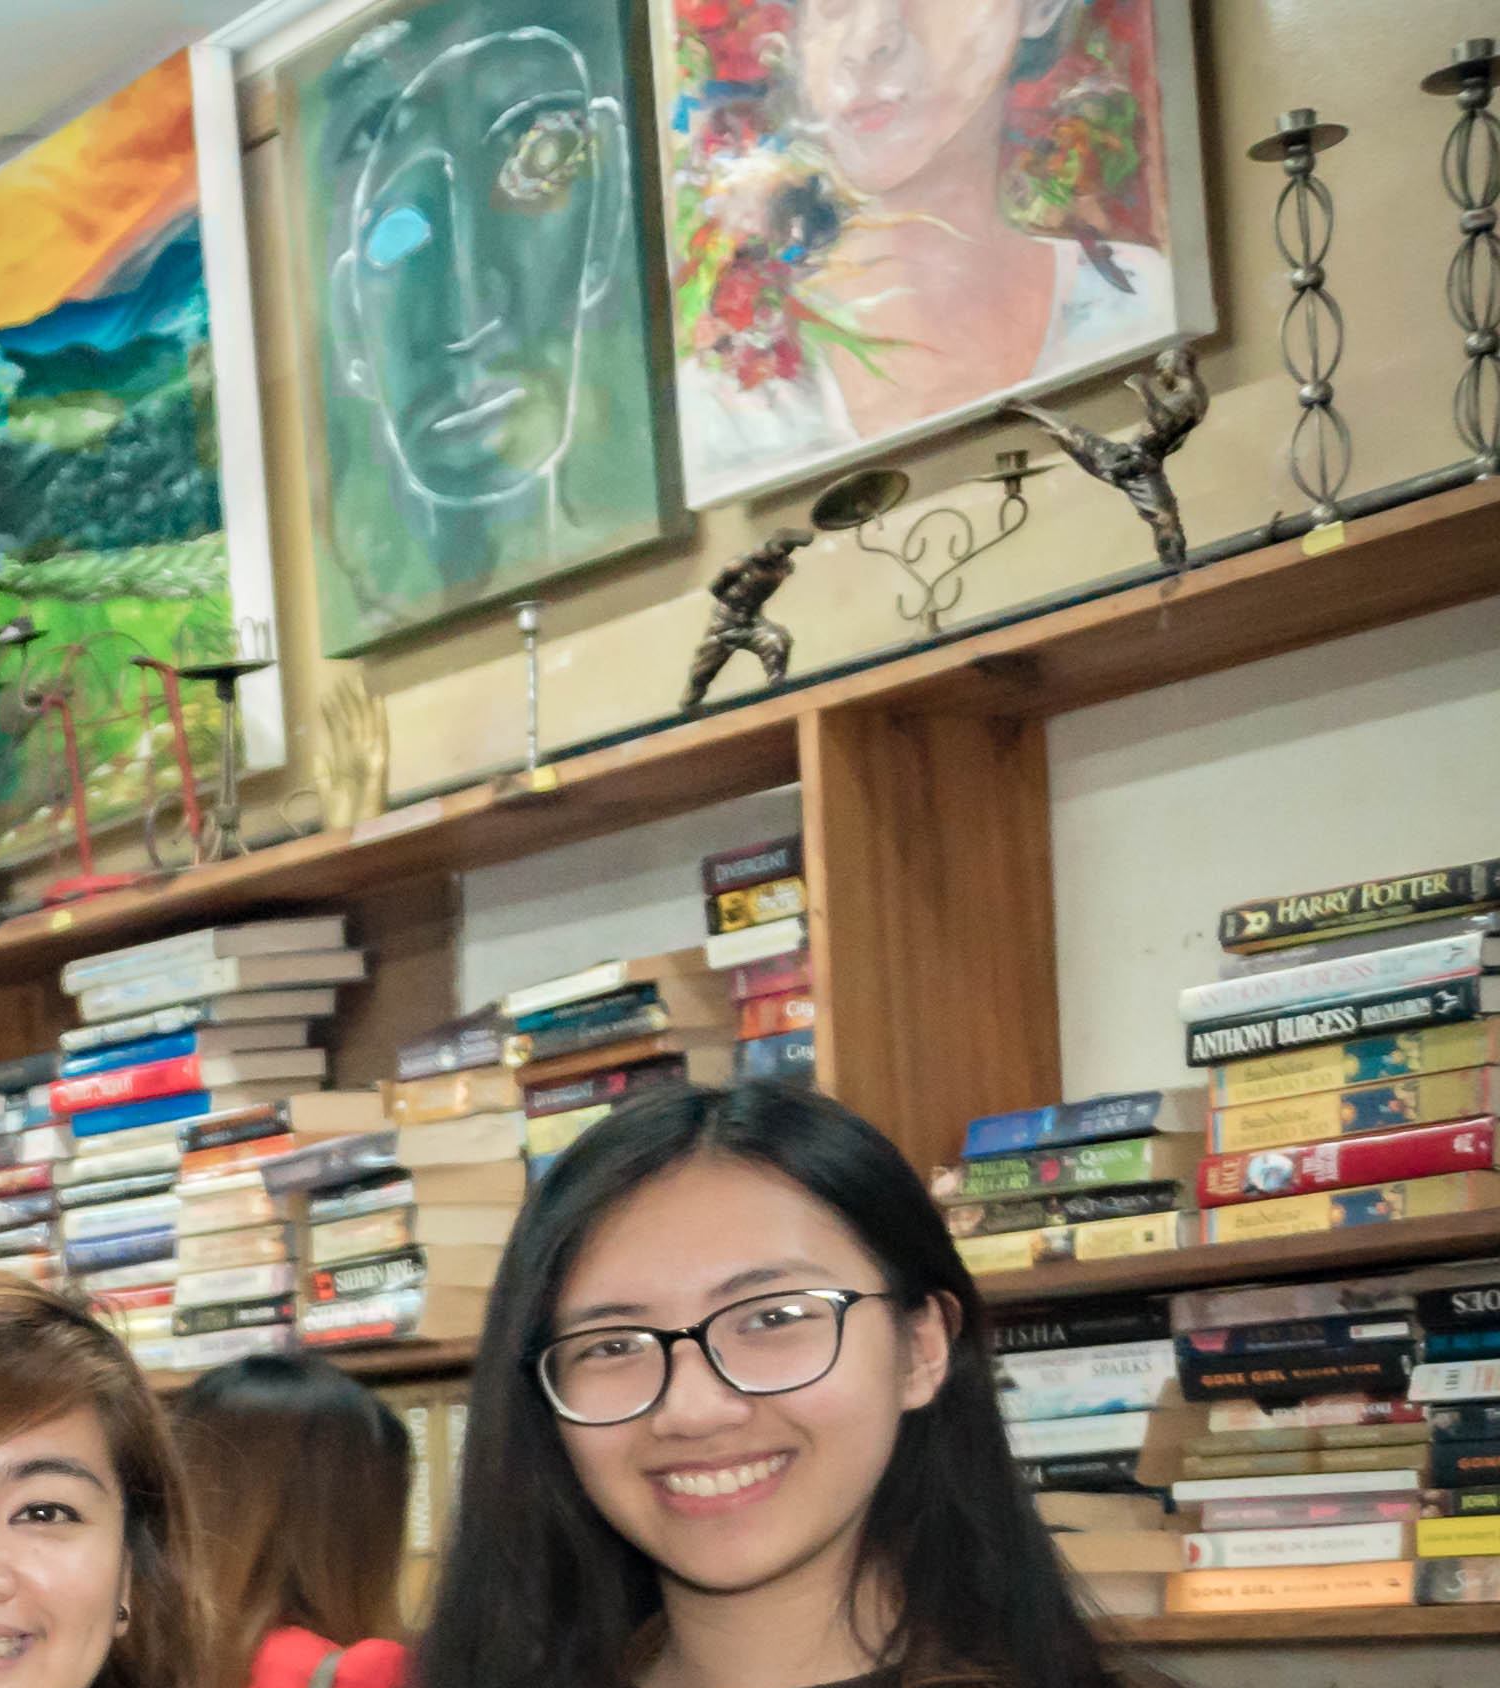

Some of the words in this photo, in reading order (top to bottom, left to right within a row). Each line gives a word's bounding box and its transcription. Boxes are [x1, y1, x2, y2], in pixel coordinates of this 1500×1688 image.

[1276, 887, 1354, 925] HARRY
[1359, 873, 1452, 910] POTTER
[1191, 1020, 1274, 1060] ANTHONY
[1276, 1005, 1358, 1043] BURGESS
